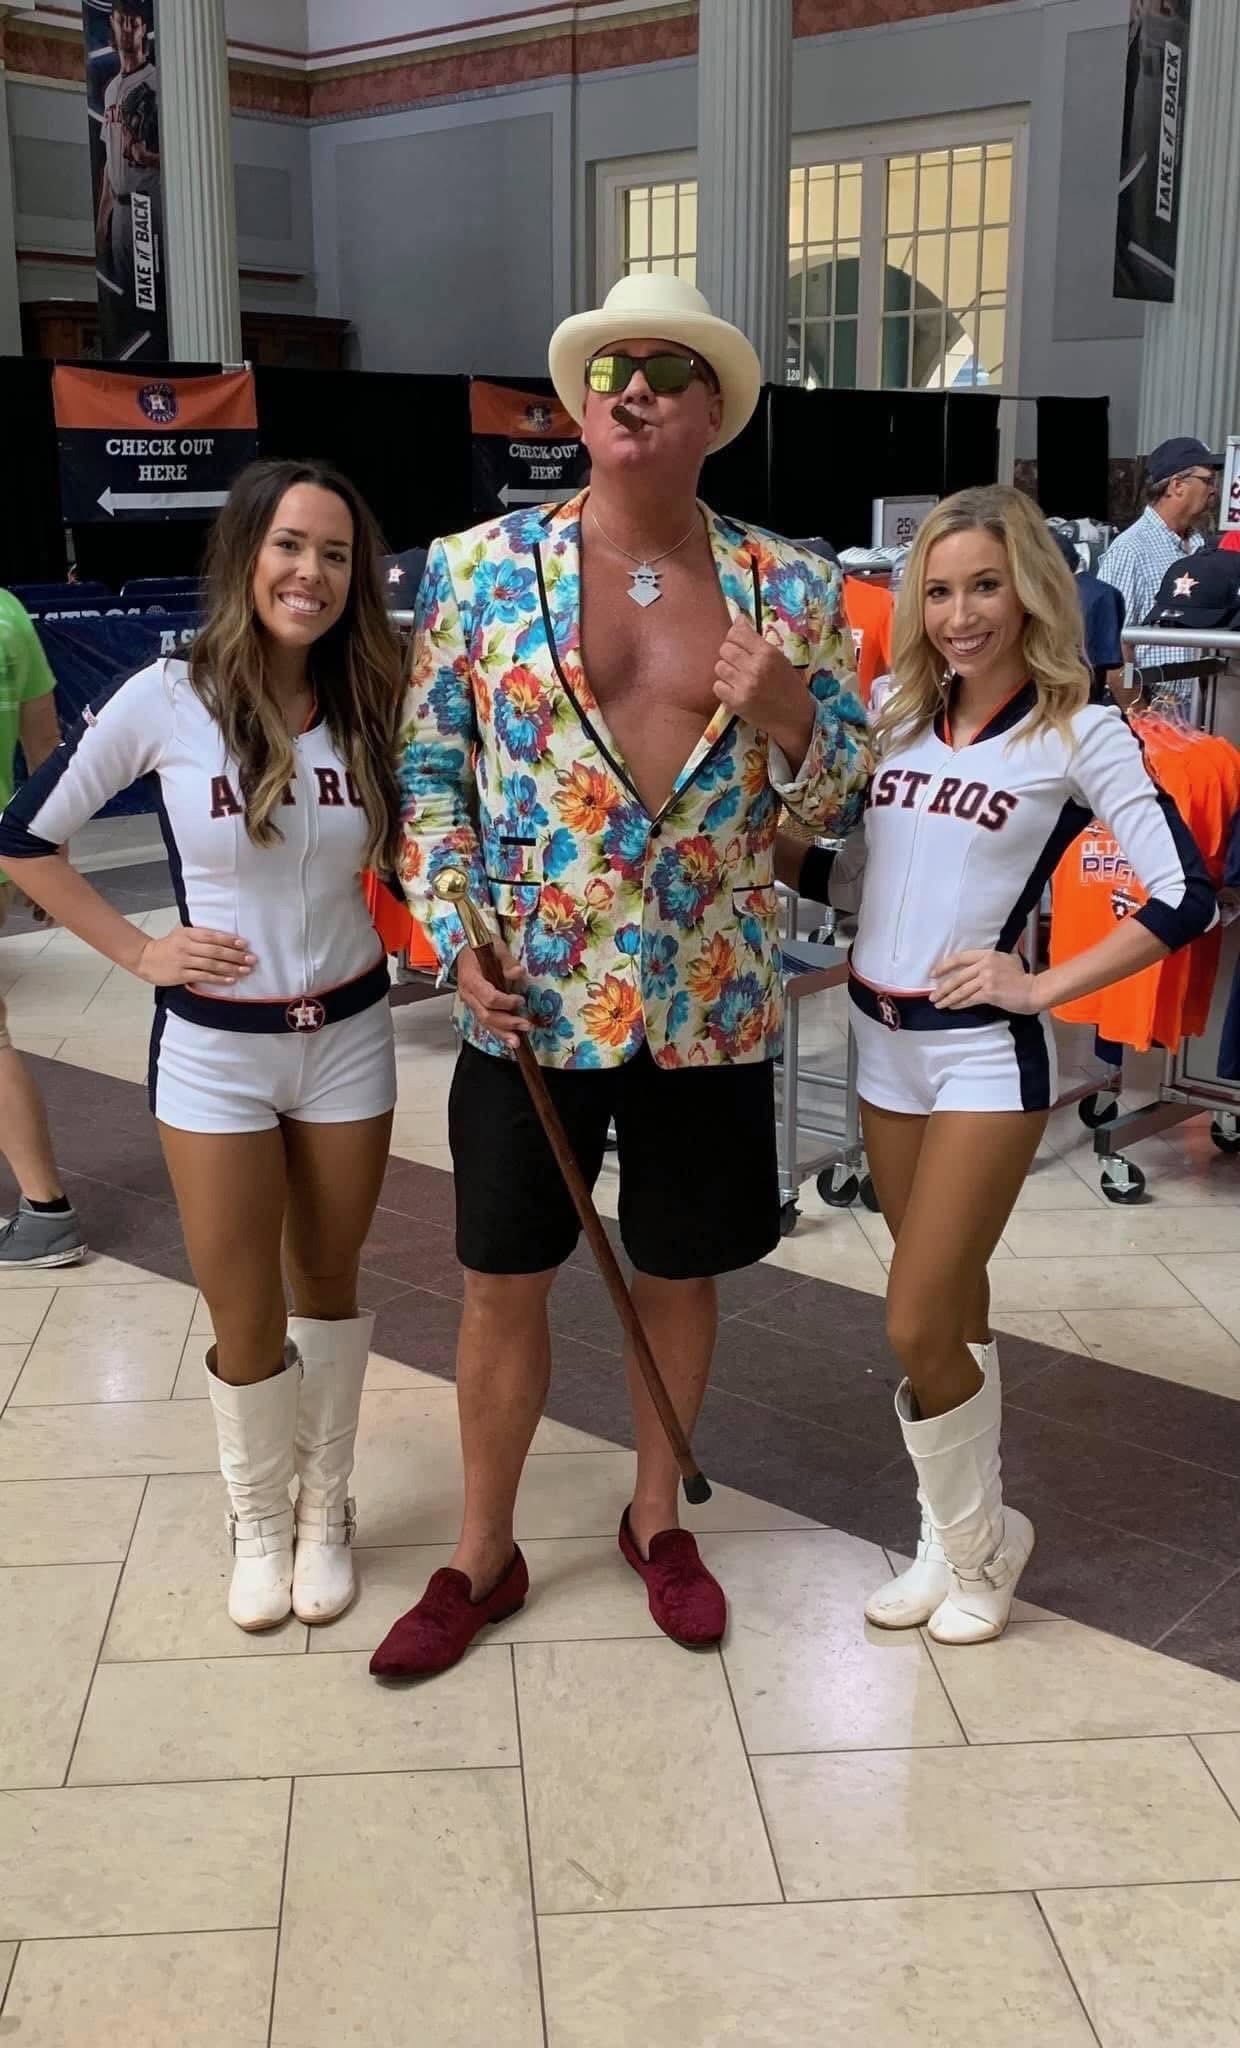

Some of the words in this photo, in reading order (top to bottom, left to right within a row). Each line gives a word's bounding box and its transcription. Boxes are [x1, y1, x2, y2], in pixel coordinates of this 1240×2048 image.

[1164, 51, 1180, 119] BACK
[1159, 152, 1173, 211] TAKE
[133, 198, 150, 243] BACK
[137, 264, 153, 304] TAKE
[105, 439, 177, 456] CHECK
[180, 438, 215, 455] OUT
[508, 443, 550, 459] CHECK
[551, 444, 579, 459] OUT
[138, 465, 188, 481] HERE
[529, 465, 563, 480] HERE
